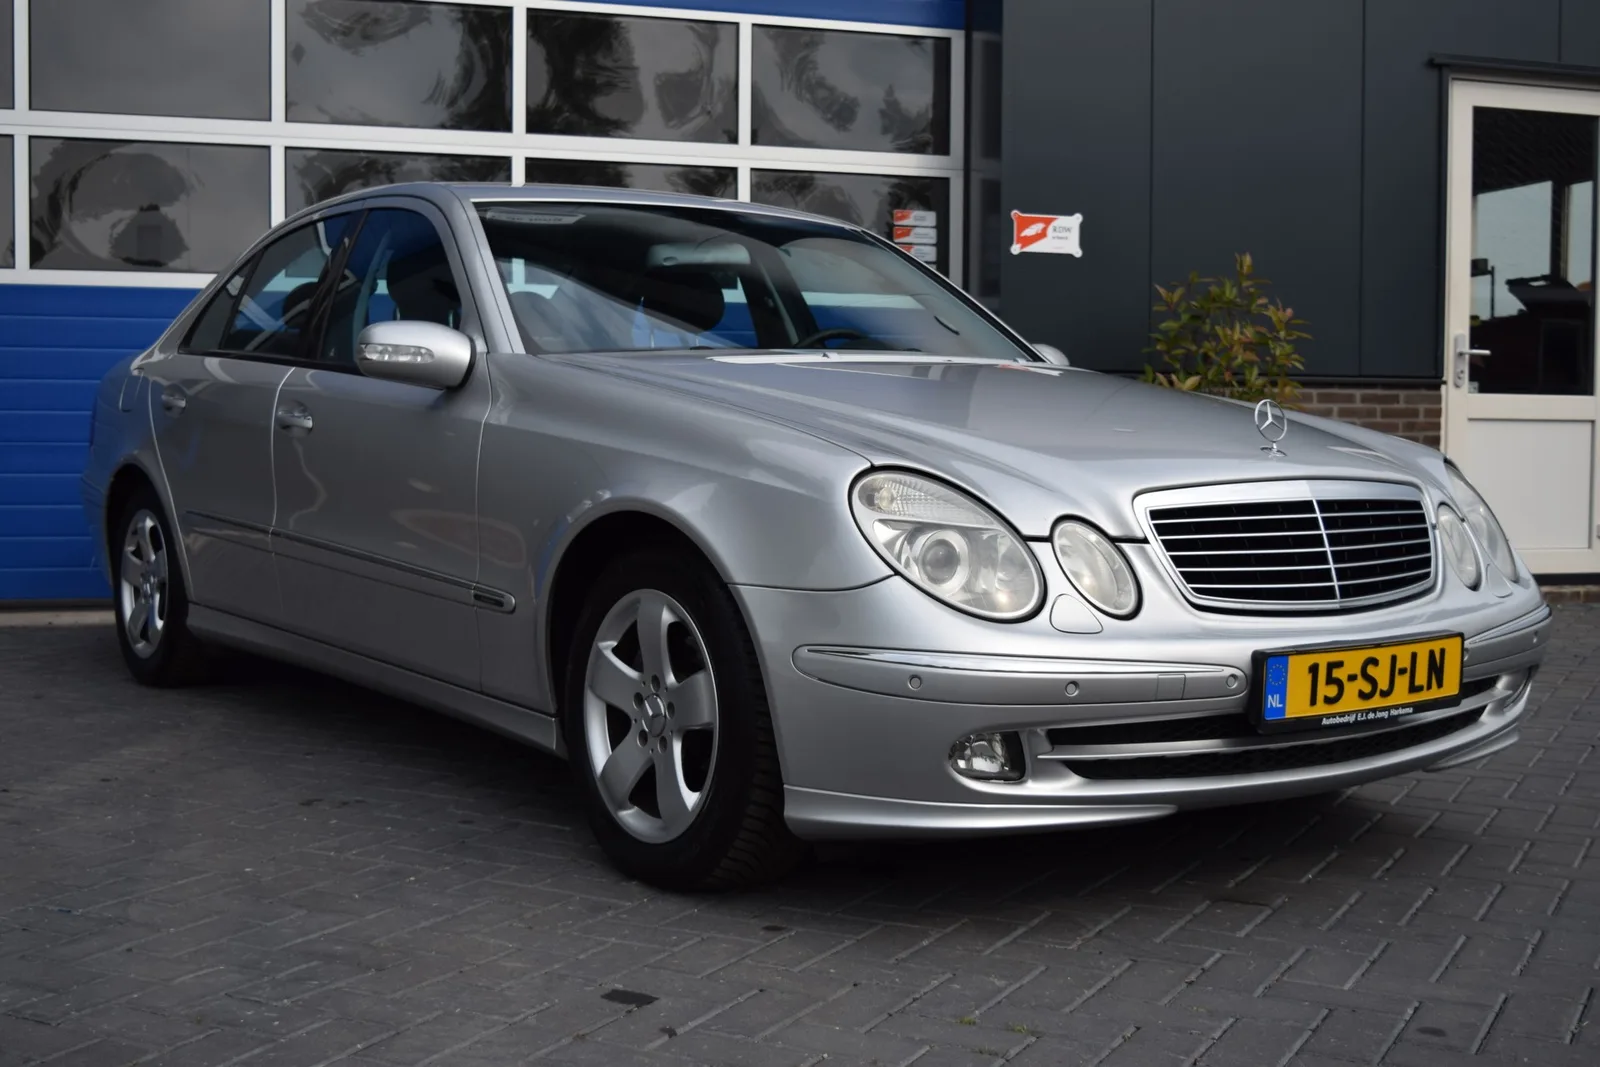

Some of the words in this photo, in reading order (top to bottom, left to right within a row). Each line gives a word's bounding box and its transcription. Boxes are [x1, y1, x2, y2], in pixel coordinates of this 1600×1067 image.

[1308, 648, 1446, 707] 15-SJ-LN
[1267, 694, 1283, 708] NL
[1321, 715, 1356, 725] Autobedrijf
[1375, 710, 1389, 718] Jong
